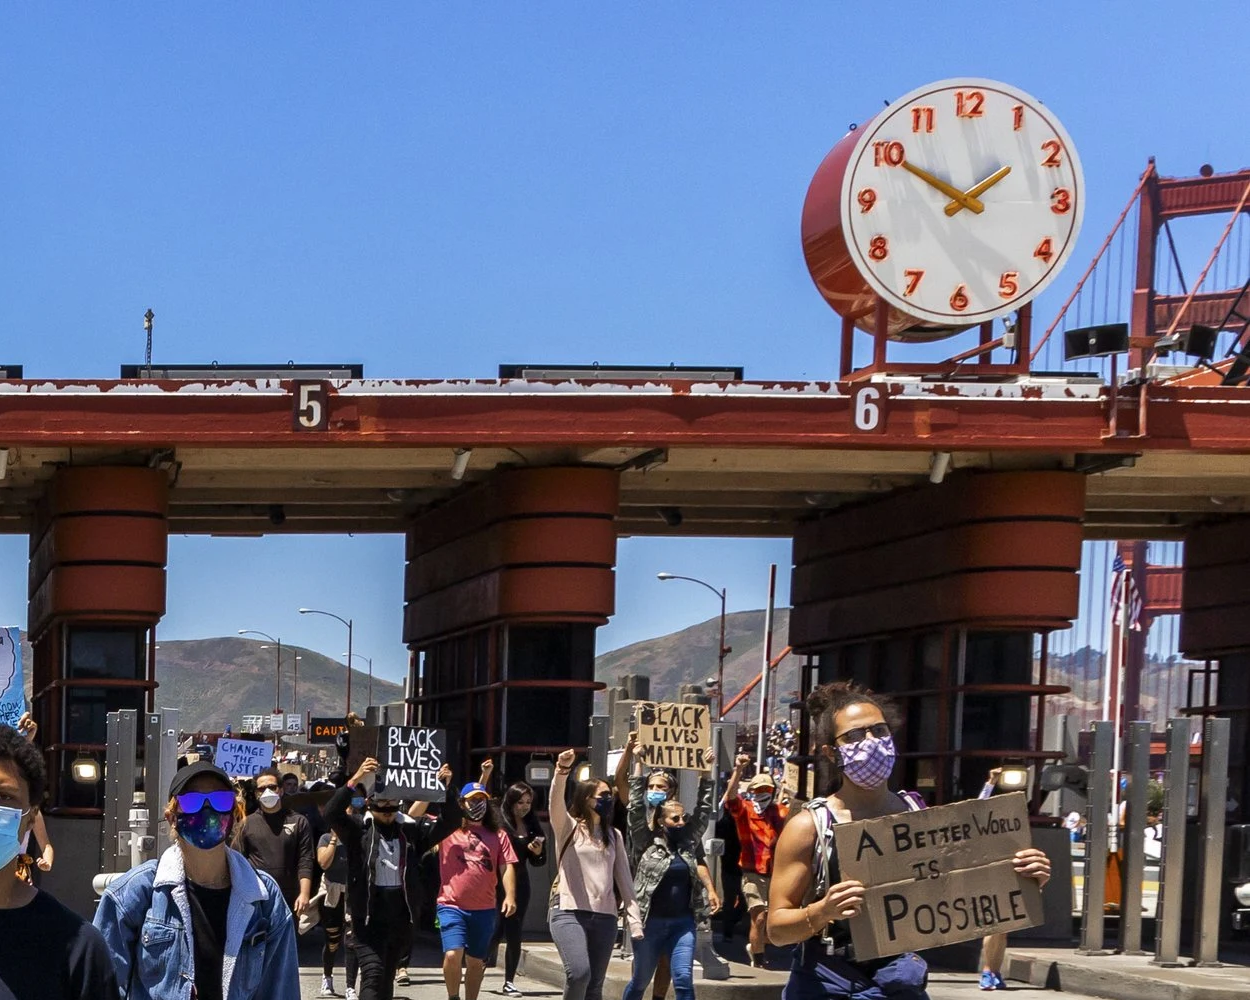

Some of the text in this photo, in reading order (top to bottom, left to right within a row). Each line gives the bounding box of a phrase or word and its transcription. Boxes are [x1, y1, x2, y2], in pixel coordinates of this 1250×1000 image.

[954, 91, 985, 118] 12
[911, 106, 936, 133] 11
[1011, 105, 1025, 131] 1
[872, 140, 905, 167] 10
[1041, 140, 1063, 166] 2
[857, 188, 877, 213] 9
[1050, 187, 1072, 214] 3
[868, 235, 888, 261] 8
[1033, 236, 1053, 262] 4
[903, 269, 924, 297] 7
[998, 272, 1019, 298] 5
[950, 284, 970, 311] 6
[299, 384, 322, 428] 5
[855, 386, 880, 430] 6
[287, 723, 300, 731] 45
[641, 704, 705, 729] BLACK
[315, 726, 347, 736] CAUT
[388, 727, 437, 749] BLACK
[653, 727, 699, 744] LIVES
[222, 742, 264, 757] CHANGE
[233, 756, 254, 764] THE
[388, 747, 441, 770] LIVES
[641, 744, 705, 769] MATTER
[855, 811, 1021, 861] A BETTER WORLD
[913, 860, 940, 881] IS
[883, 889, 1026, 941] POSSIBLE
